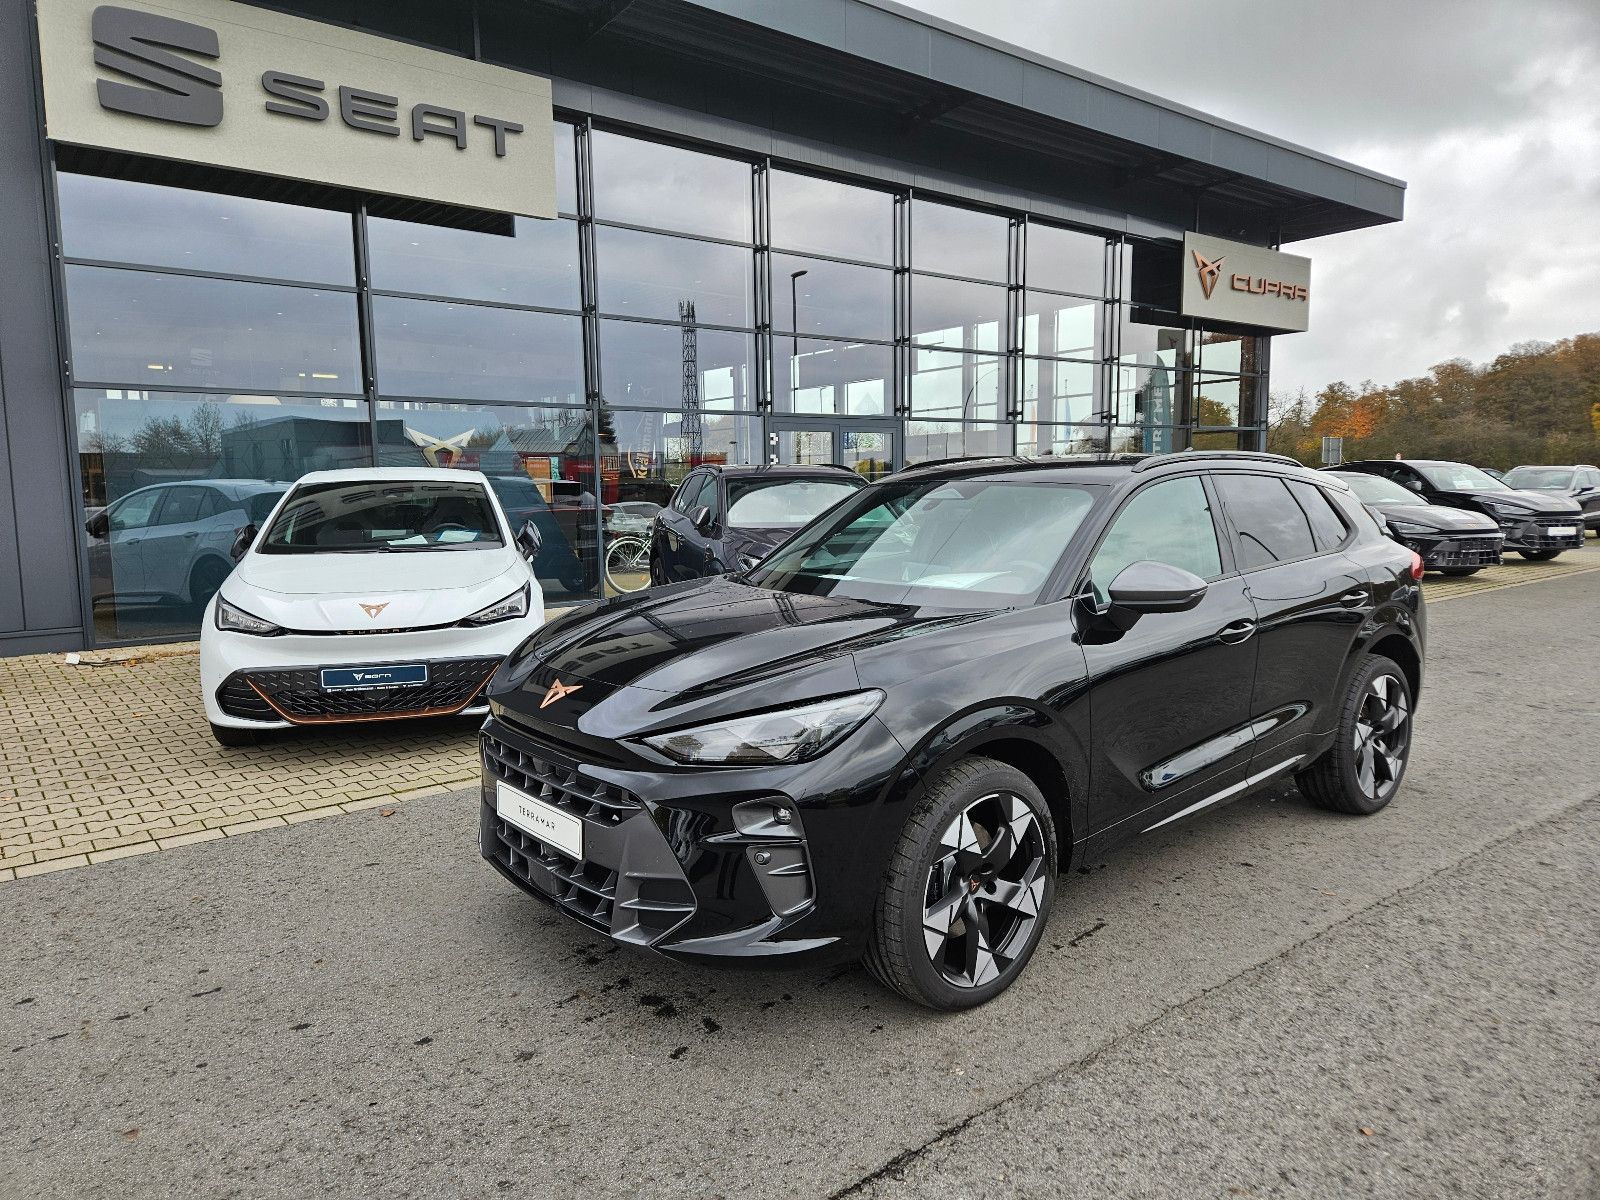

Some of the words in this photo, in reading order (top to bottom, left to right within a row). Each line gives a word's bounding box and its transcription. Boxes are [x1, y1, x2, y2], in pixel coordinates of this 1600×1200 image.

[261, 70, 524, 157] SEAT
[1231, 273, 1309, 302] CUPRA
[518, 805, 556, 831] TERRAMAR
